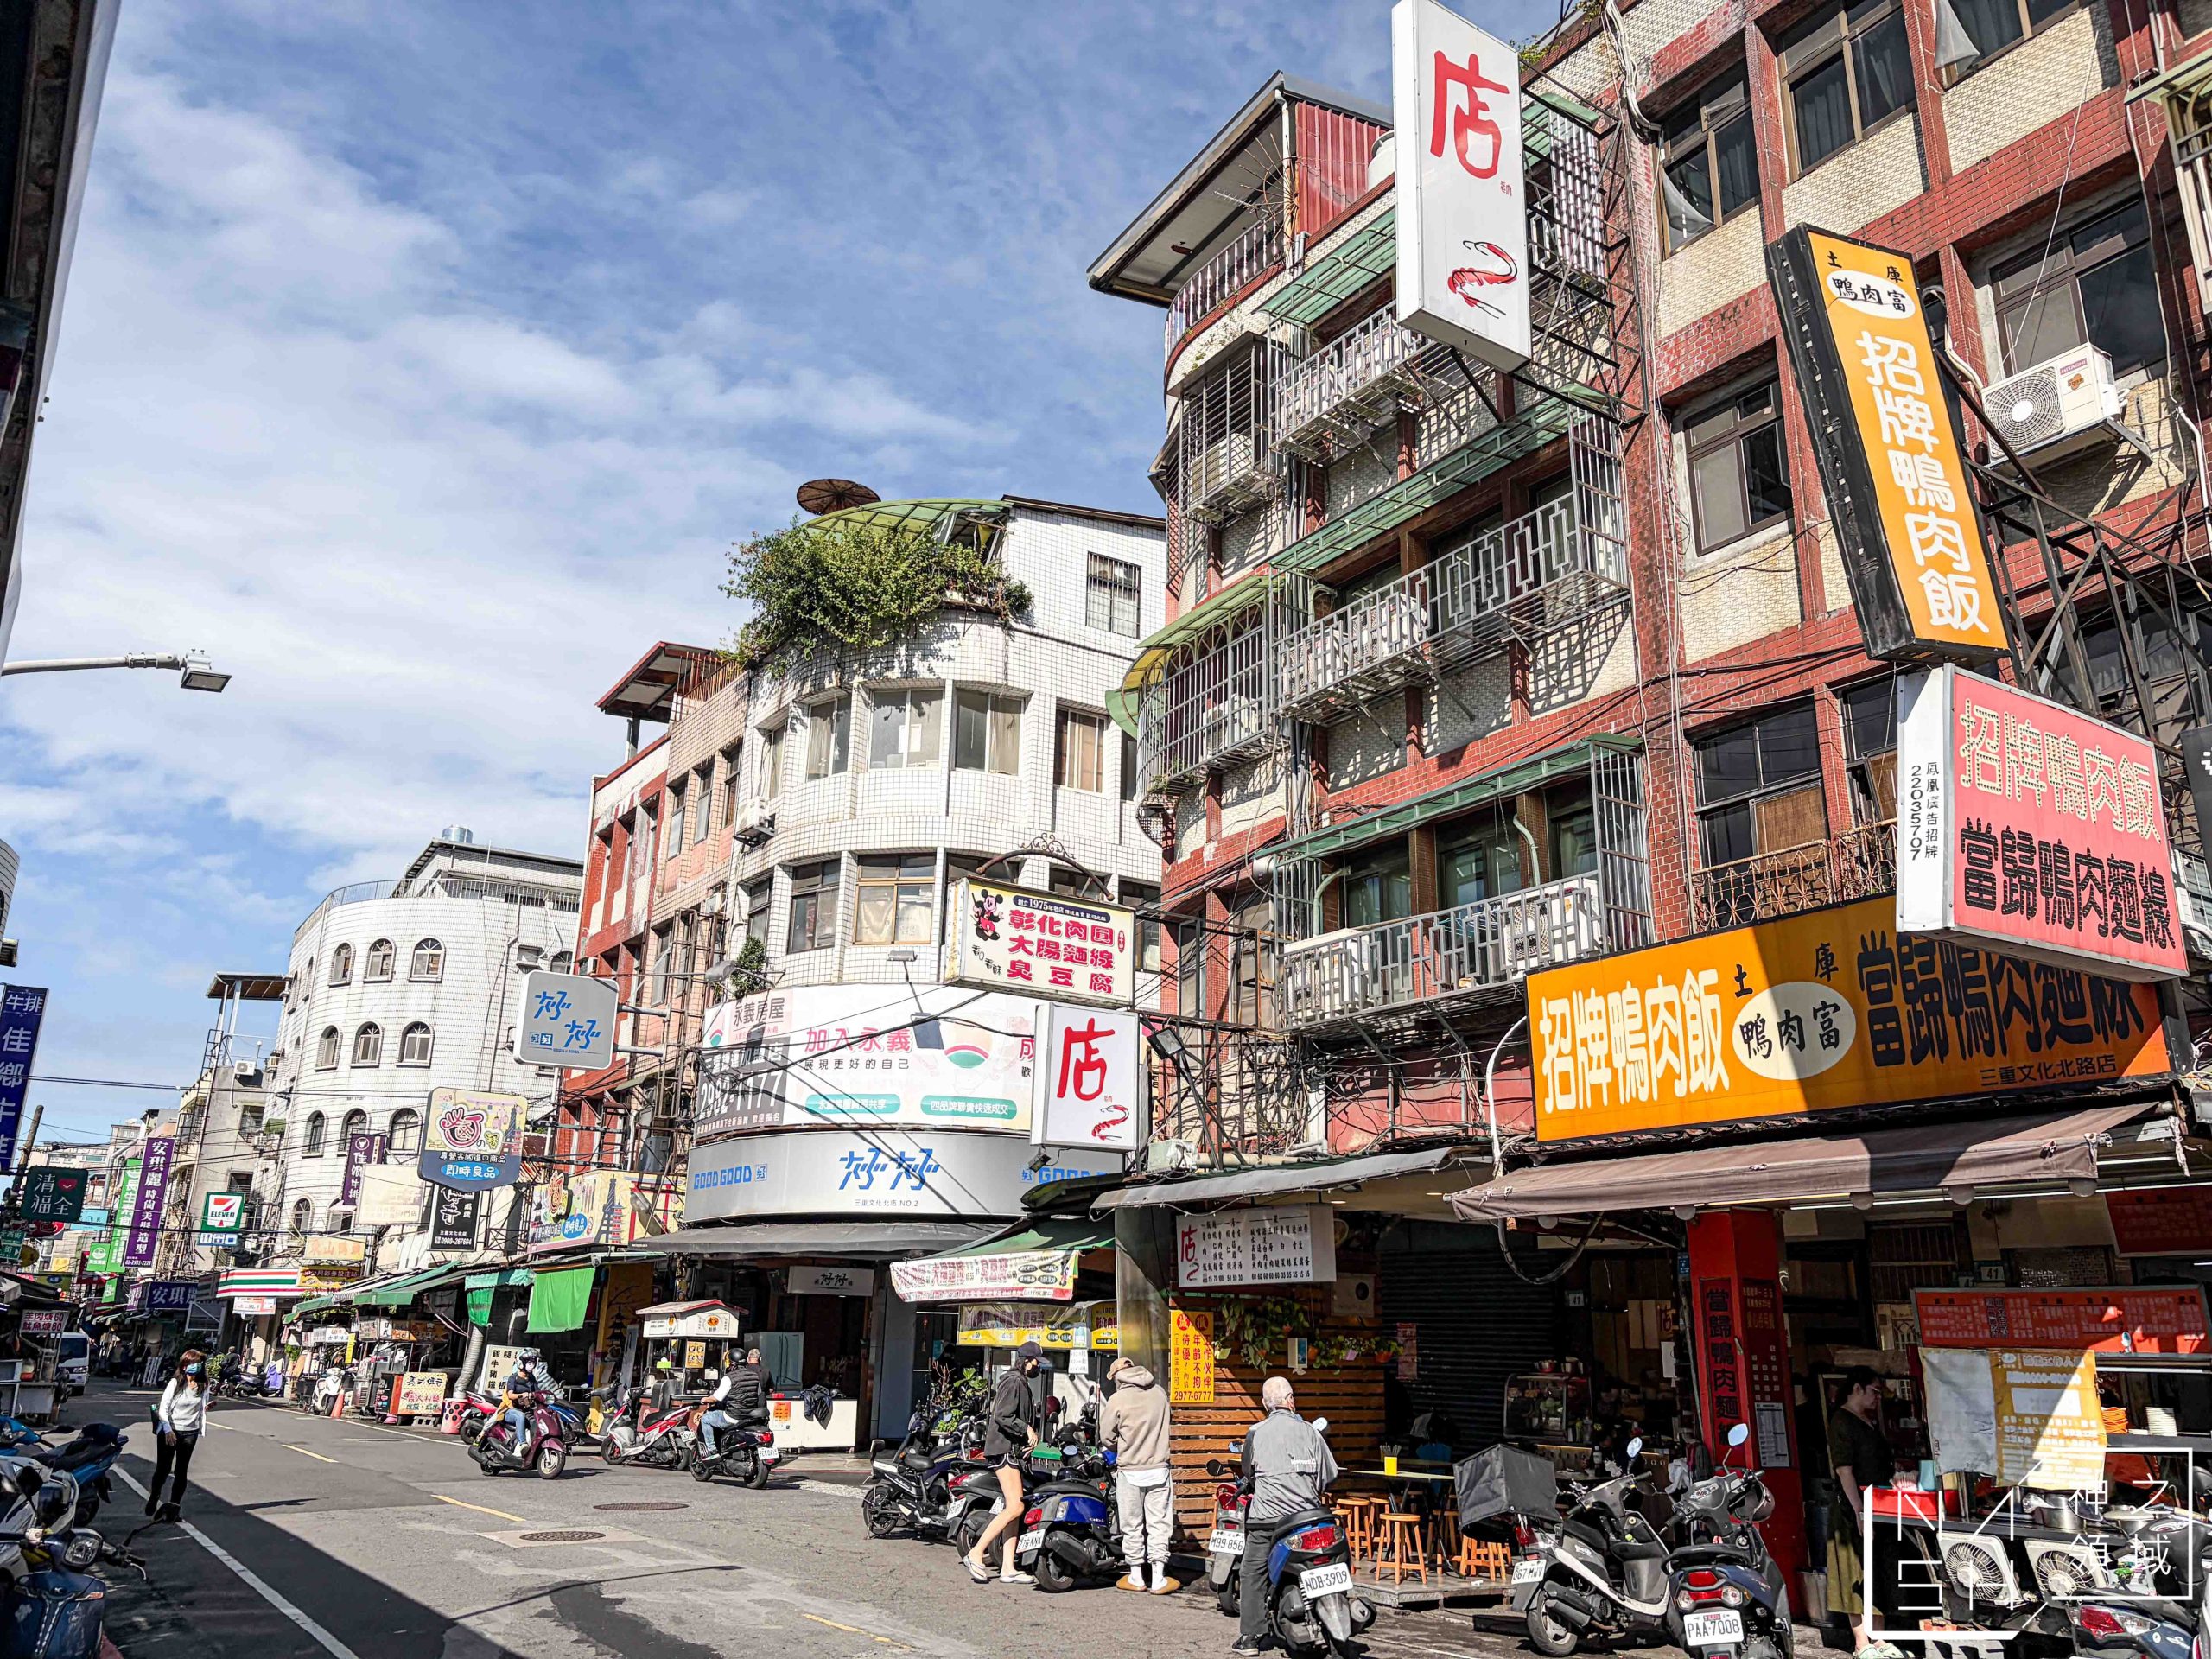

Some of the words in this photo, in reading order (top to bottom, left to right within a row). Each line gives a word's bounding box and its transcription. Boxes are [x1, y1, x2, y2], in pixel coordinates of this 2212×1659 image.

[1430, 49, 1510, 180] 店
[1831, 276, 1907, 314] 鴨肉富
[1855, 330, 1990, 634] 招牌鴨肉飯
[1959, 697, 2162, 844] 招牌鴨肉飯
[1910, 765, 1923, 861] 22035707
[1924, 762, 1940, 860] 鳳凰廣告招牌
[1960, 817, 2177, 950] 當歸鴨肉麵線
[1008, 909, 1115, 946] 彰化肉圓
[1007, 959, 1114, 995] 臭豆腐
[6, 995, 44, 1014] 牛排
[733, 996, 785, 1027] 永義房屋
[804, 1026, 912, 1054] 加入永義
[1539, 968, 1731, 1114] 招牌鴨肉飯
[1740, 1001, 1841, 1060] 鴨肉富
[804, 1058, 910, 1071] 展現更好的自己
[1056, 1016, 1116, 1102] 店
[1980, 1055, 2117, 1087] 三重文化北路店
[143, 1141, 169, 1187] 安琪麗
[445, 1164, 497, 1179] 即時良品
[694, 1169, 719, 1190] GOOD
[719, 1166, 753, 1187] GOOD
[34, 1173, 56, 1193] 清
[31, 1194, 73, 1216] 福全
[1174, 1390, 1211, 1401] 2977-6777
[1687, 1618, 1741, 1640] PAA-7008
